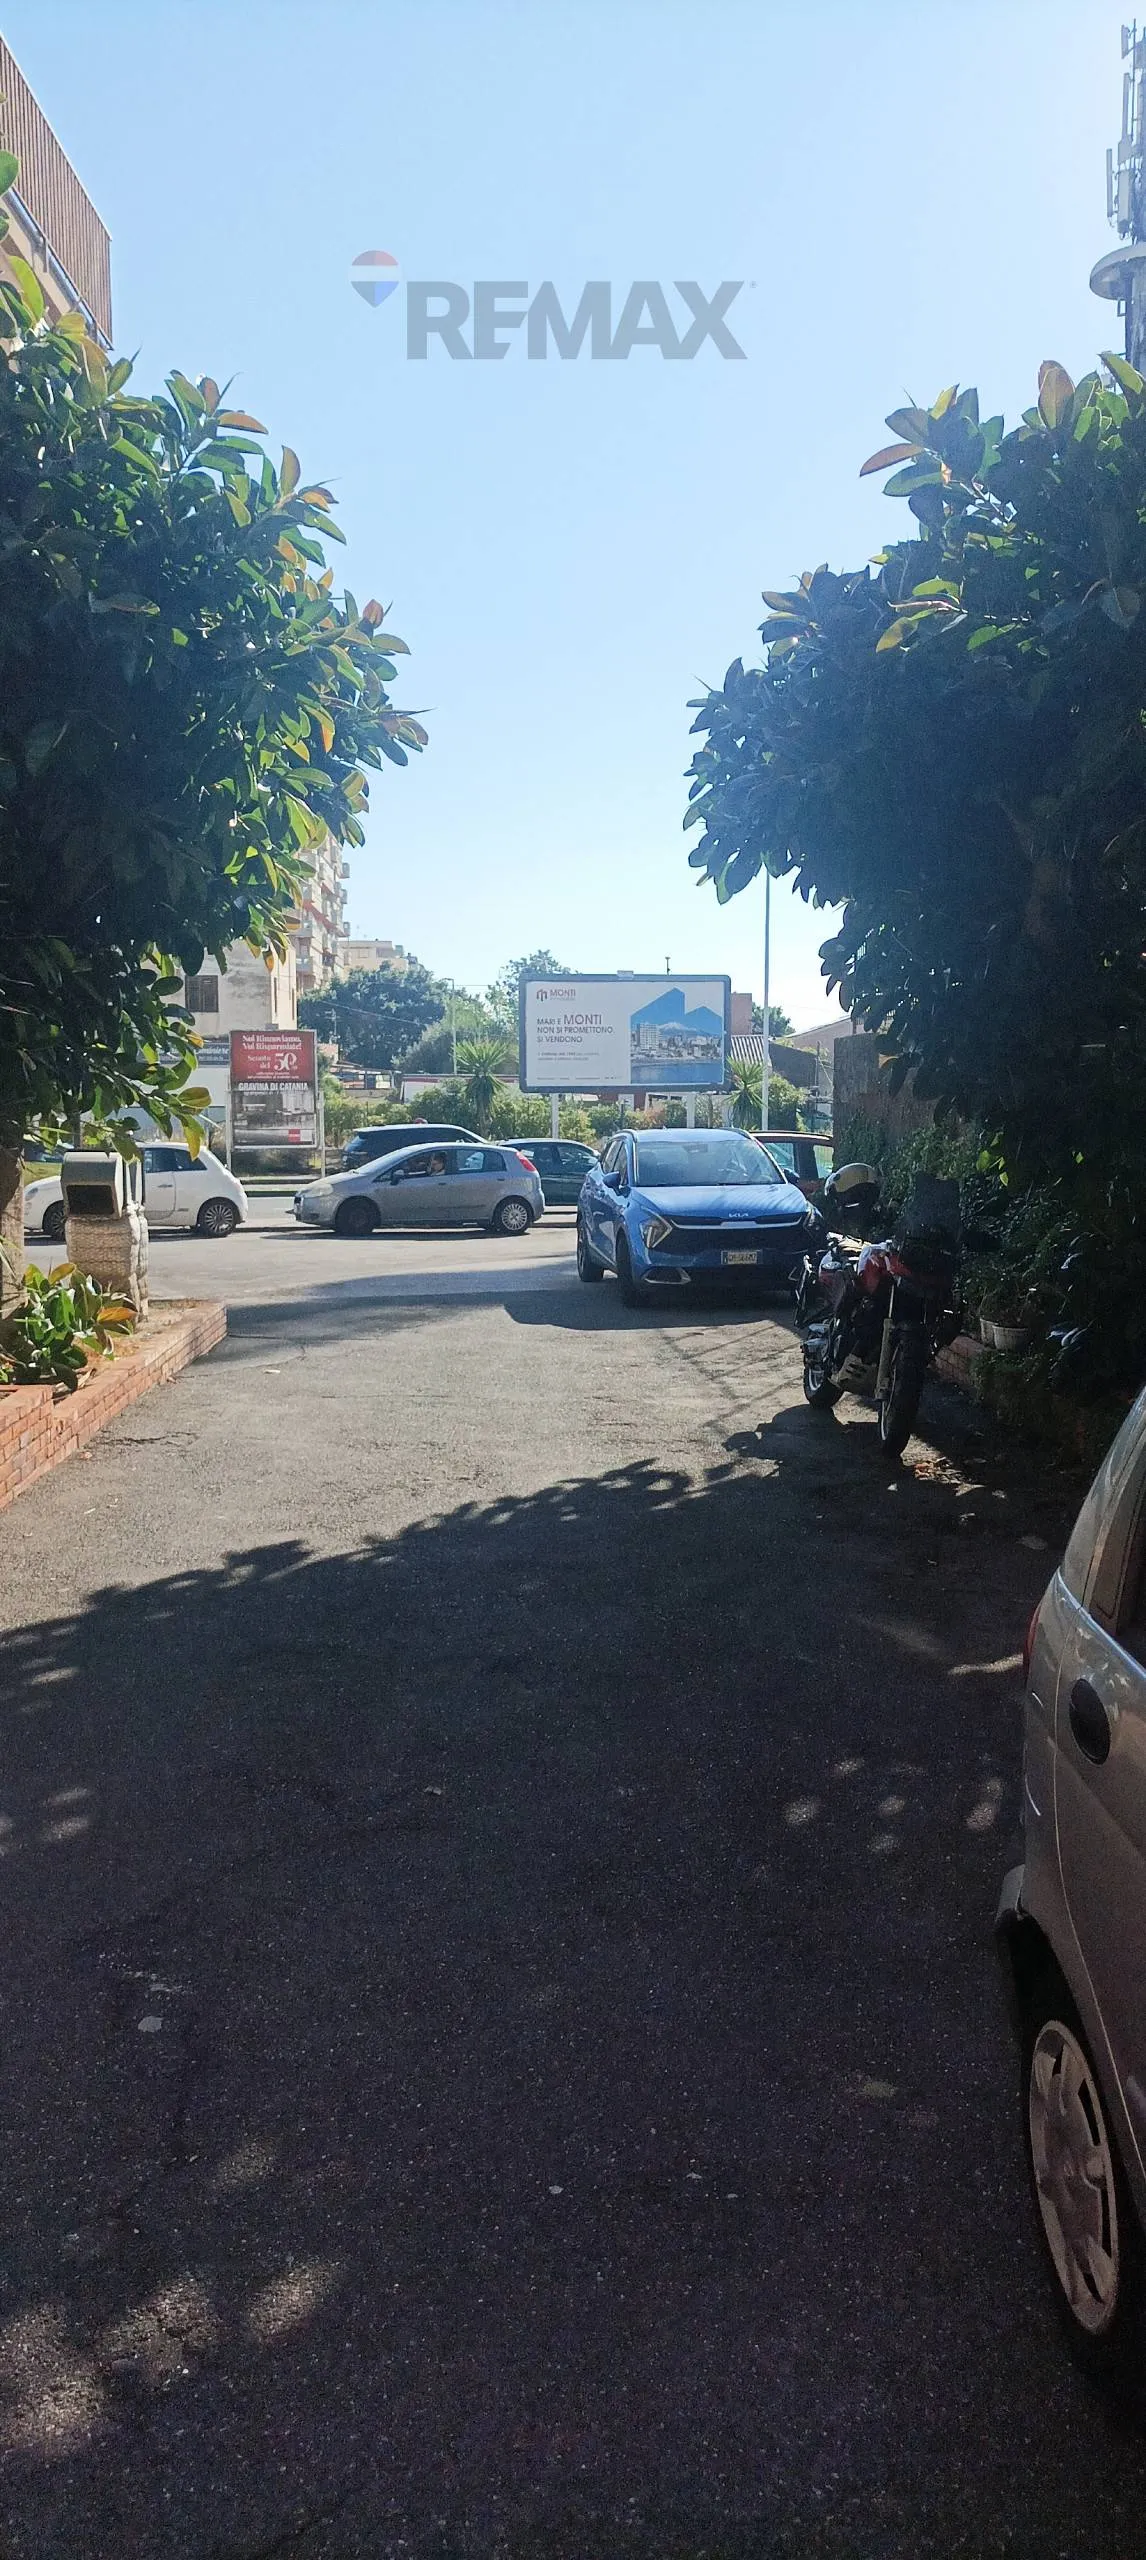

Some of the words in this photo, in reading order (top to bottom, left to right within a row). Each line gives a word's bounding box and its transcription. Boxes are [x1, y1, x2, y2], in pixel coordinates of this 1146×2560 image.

[549, 989, 576, 997] MONTI
[563, 1014, 602, 1025] MONTI
[536, 1026, 555, 1034] NON
[556, 1026, 563, 1034] SI
[238, 1082, 270, 1091] GRAVINA
[270, 1082, 279, 1091] DI
[279, 1082, 309, 1091] CATANIA
